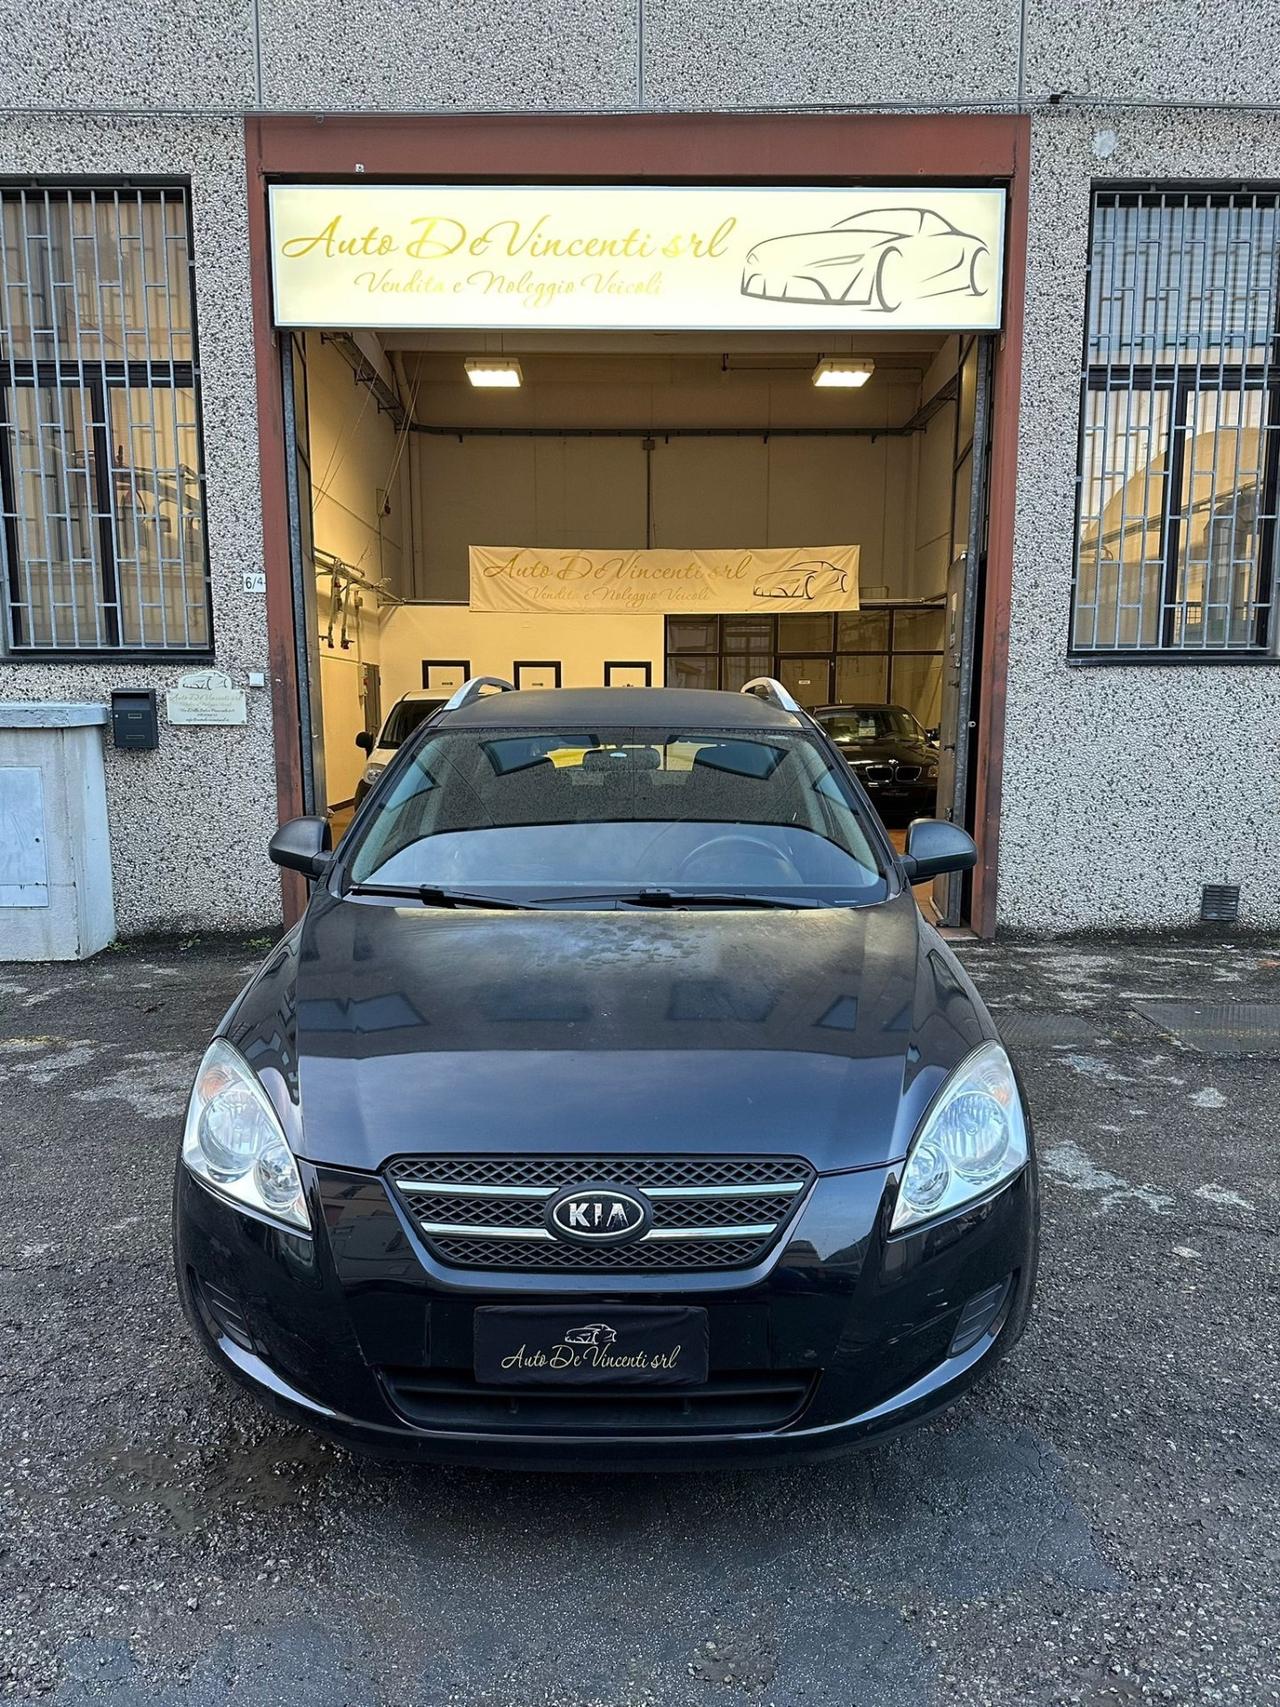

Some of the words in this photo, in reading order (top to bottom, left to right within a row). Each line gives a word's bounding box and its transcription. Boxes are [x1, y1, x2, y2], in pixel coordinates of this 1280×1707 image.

[281, 214, 399, 259] Auto
[484, 213, 656, 258] Vincenti
[662, 216, 737, 259] srl
[353, 268, 446, 294] Vendita
[452, 280, 462, 294] e
[466, 269, 576, 309] Noleggio
[580, 269, 664, 295] Veicoli
[482, 553, 553, 579] Auto
[708, 554, 753, 580] srl
[245, 576, 263, 590] 6/4
[525, 584, 581, 601] Vendit
[568, 1202, 630, 1228] KIA
[500, 1343, 548, 1369] Auto
[549, 1344, 582, 1370] De
[582, 1342, 648, 1369] Vincenti
[649, 1344, 682, 1370] srl
